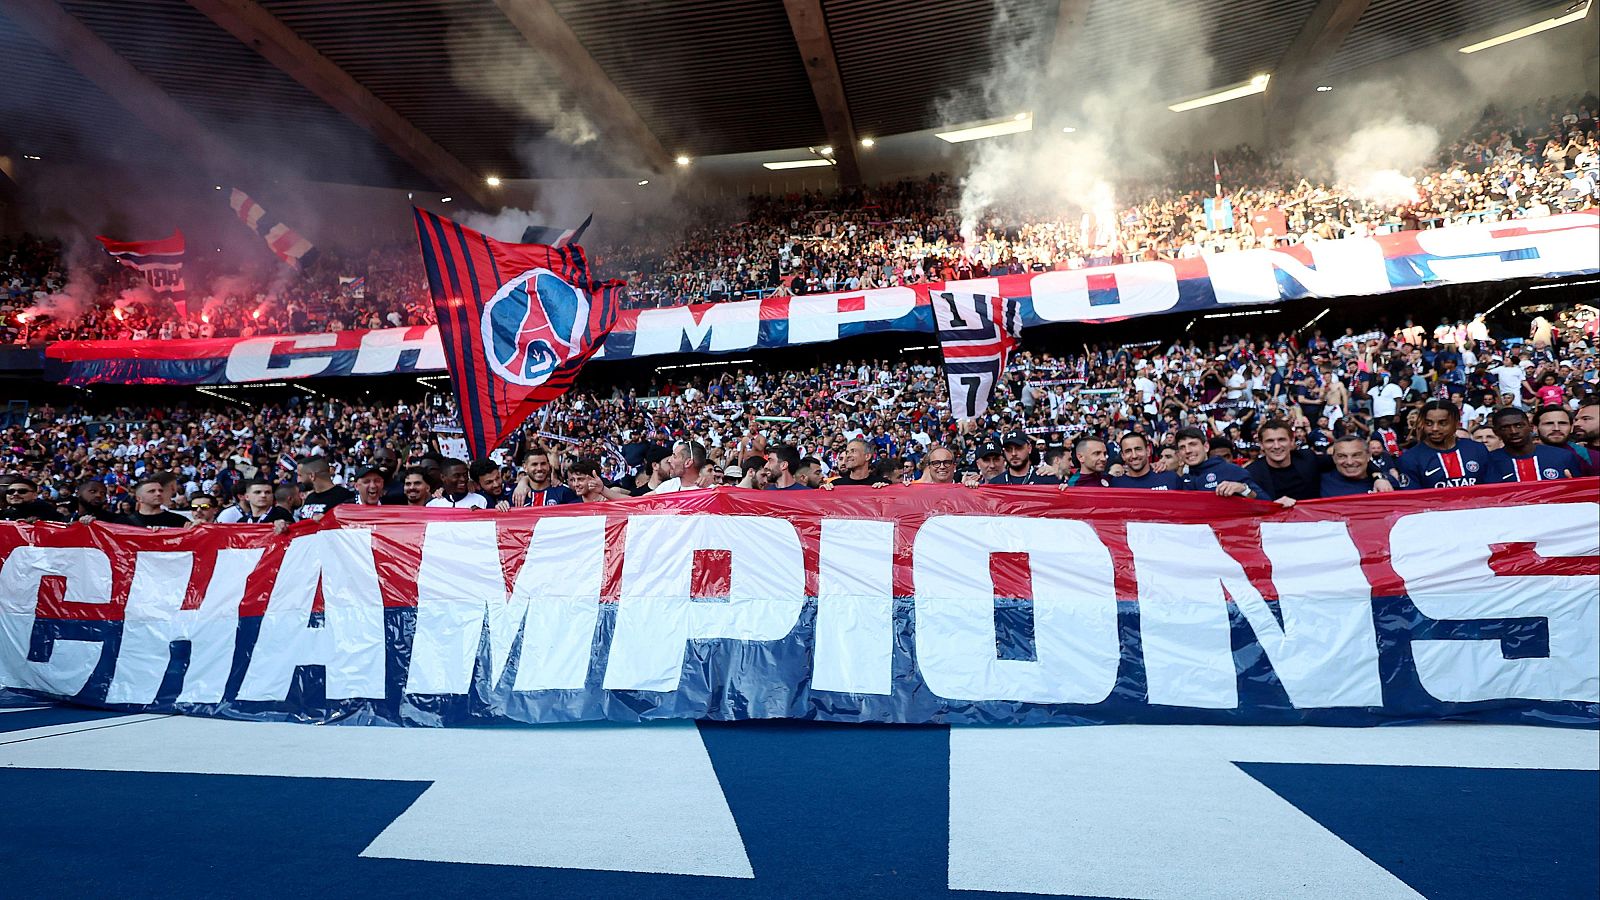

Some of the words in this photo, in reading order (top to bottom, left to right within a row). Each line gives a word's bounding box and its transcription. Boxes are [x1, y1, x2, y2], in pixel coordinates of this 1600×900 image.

[225, 213, 1599, 382] CHMPONS
[941, 293, 967, 327] 1
[433, 397, 442, 407] 13
[961, 377, 981, 417] 7
[1434, 477, 1477, 488] QATAR
[0, 502, 1598, 709] CHAMPIONS
